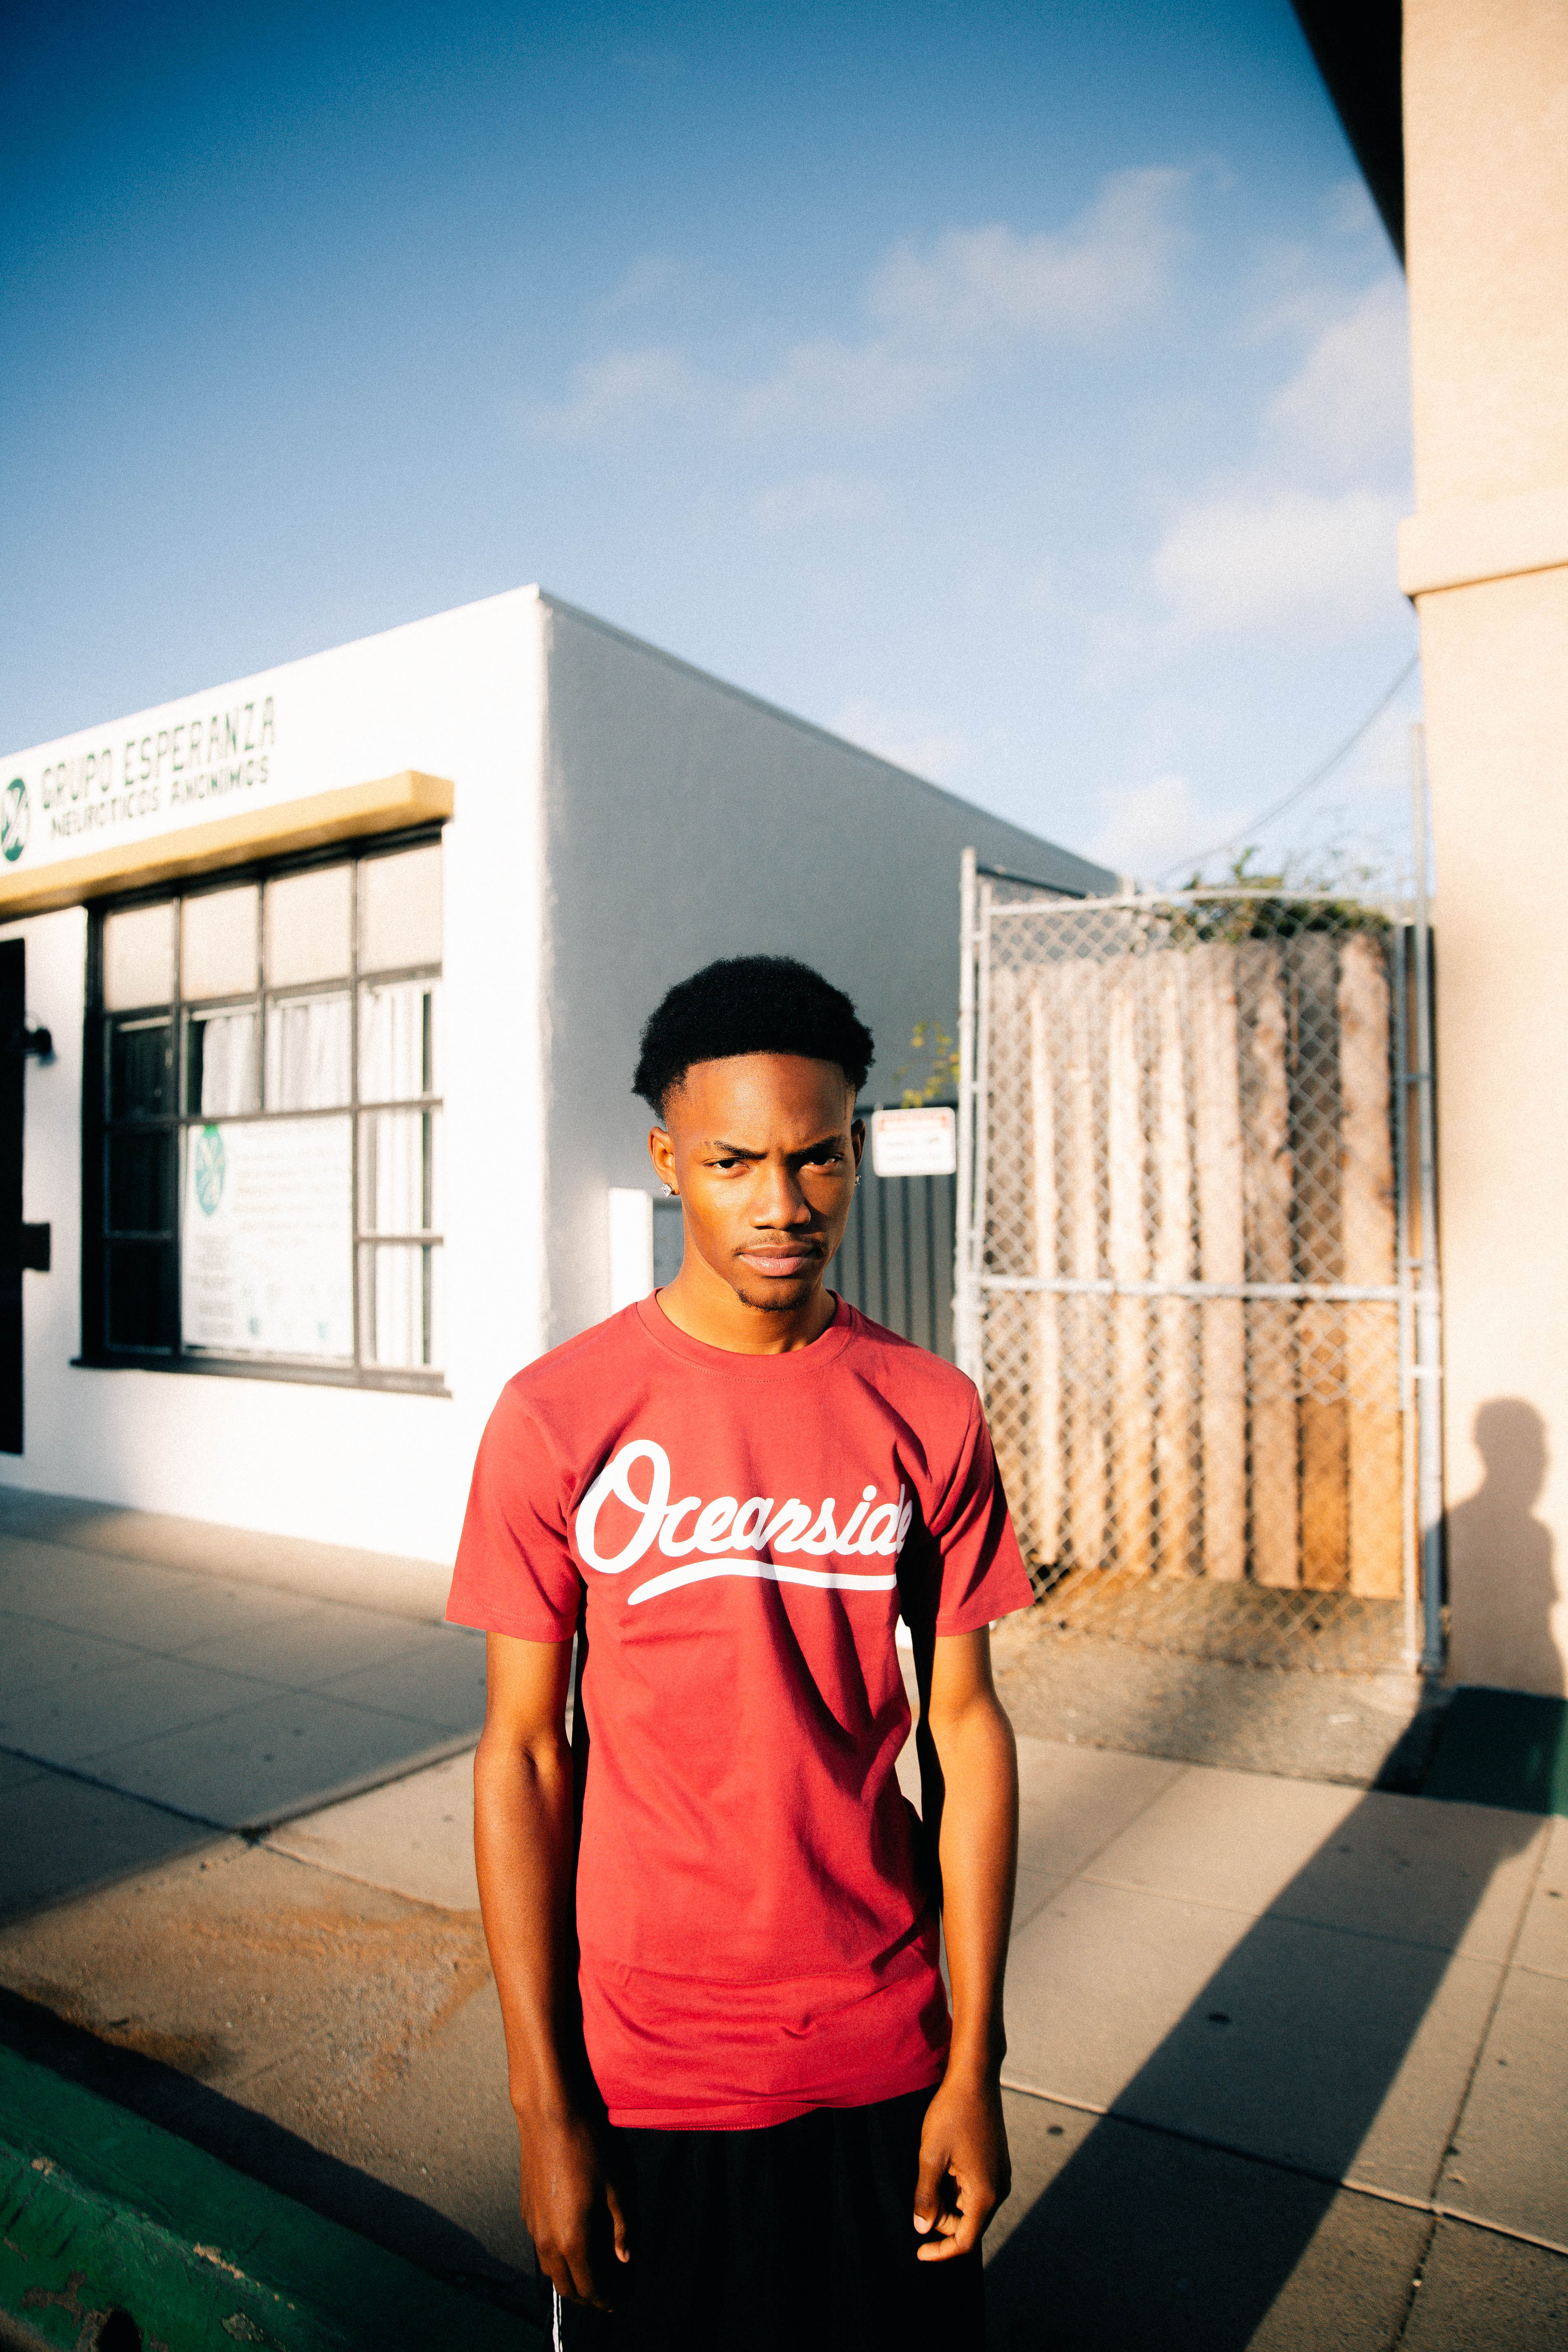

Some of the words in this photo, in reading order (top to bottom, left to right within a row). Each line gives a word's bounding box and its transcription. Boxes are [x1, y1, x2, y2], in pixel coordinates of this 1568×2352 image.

[41, 748, 113, 810] GRUPO
[123, 695, 275, 786] ESPERANZA
[575, 1439, 913, 1574] Oceanside
